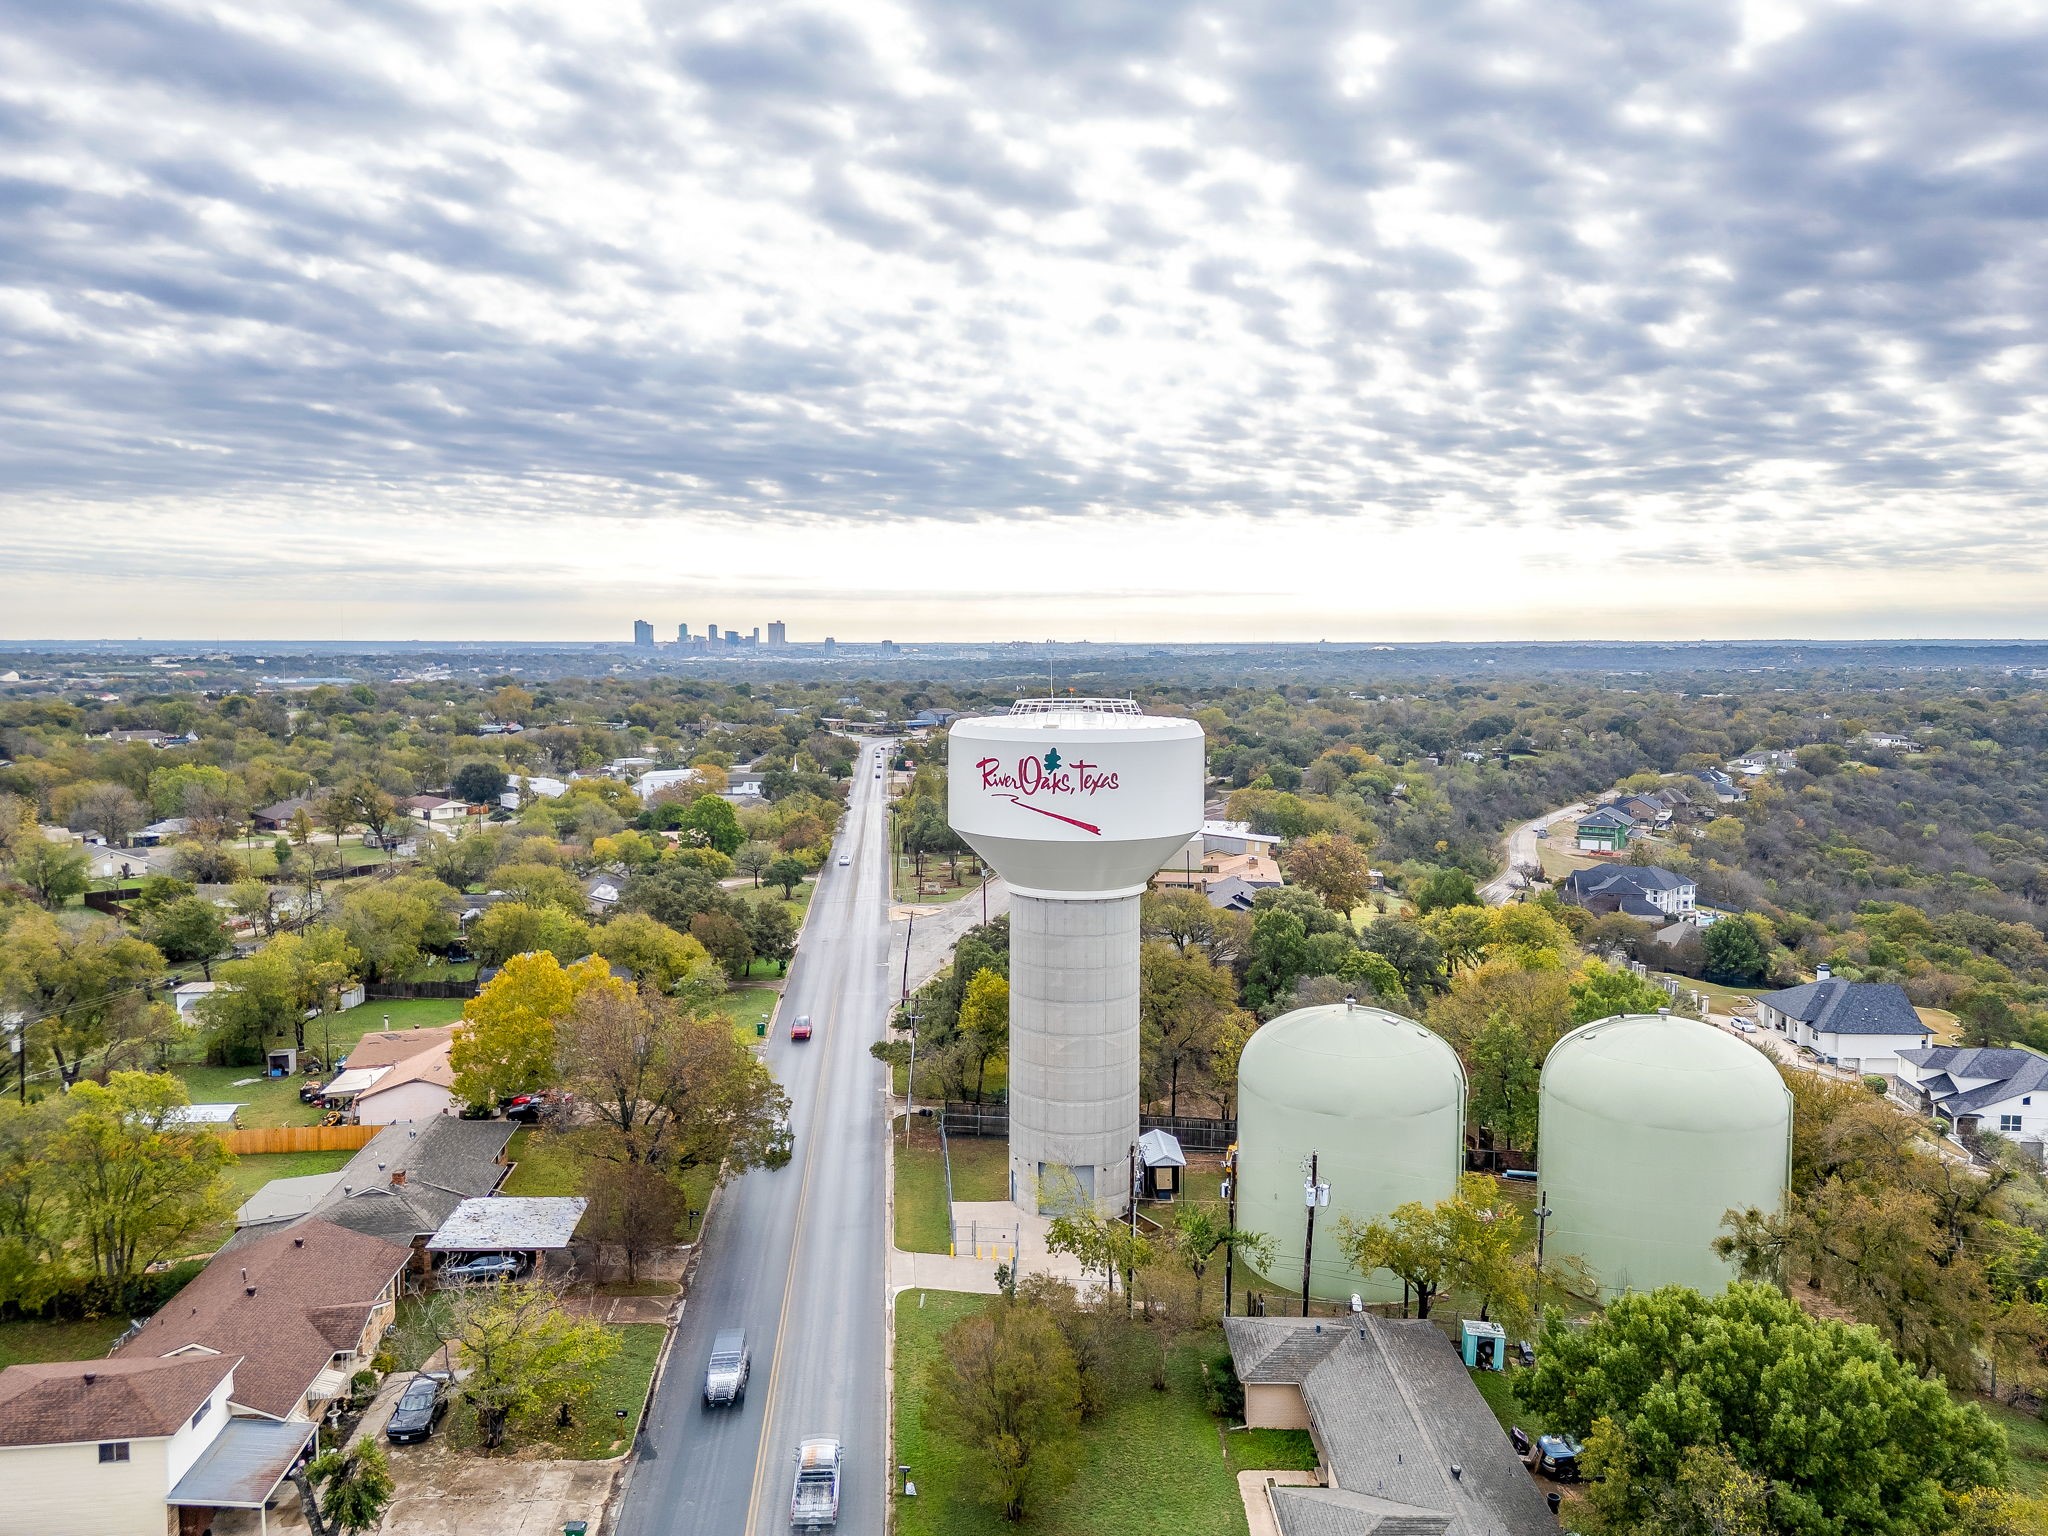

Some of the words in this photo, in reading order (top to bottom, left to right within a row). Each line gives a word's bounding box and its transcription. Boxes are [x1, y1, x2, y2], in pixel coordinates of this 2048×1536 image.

[975, 757, 1020, 791] River
[1018, 755, 1075, 796] Oaks,
[1069, 759, 1120, 796] Texas
